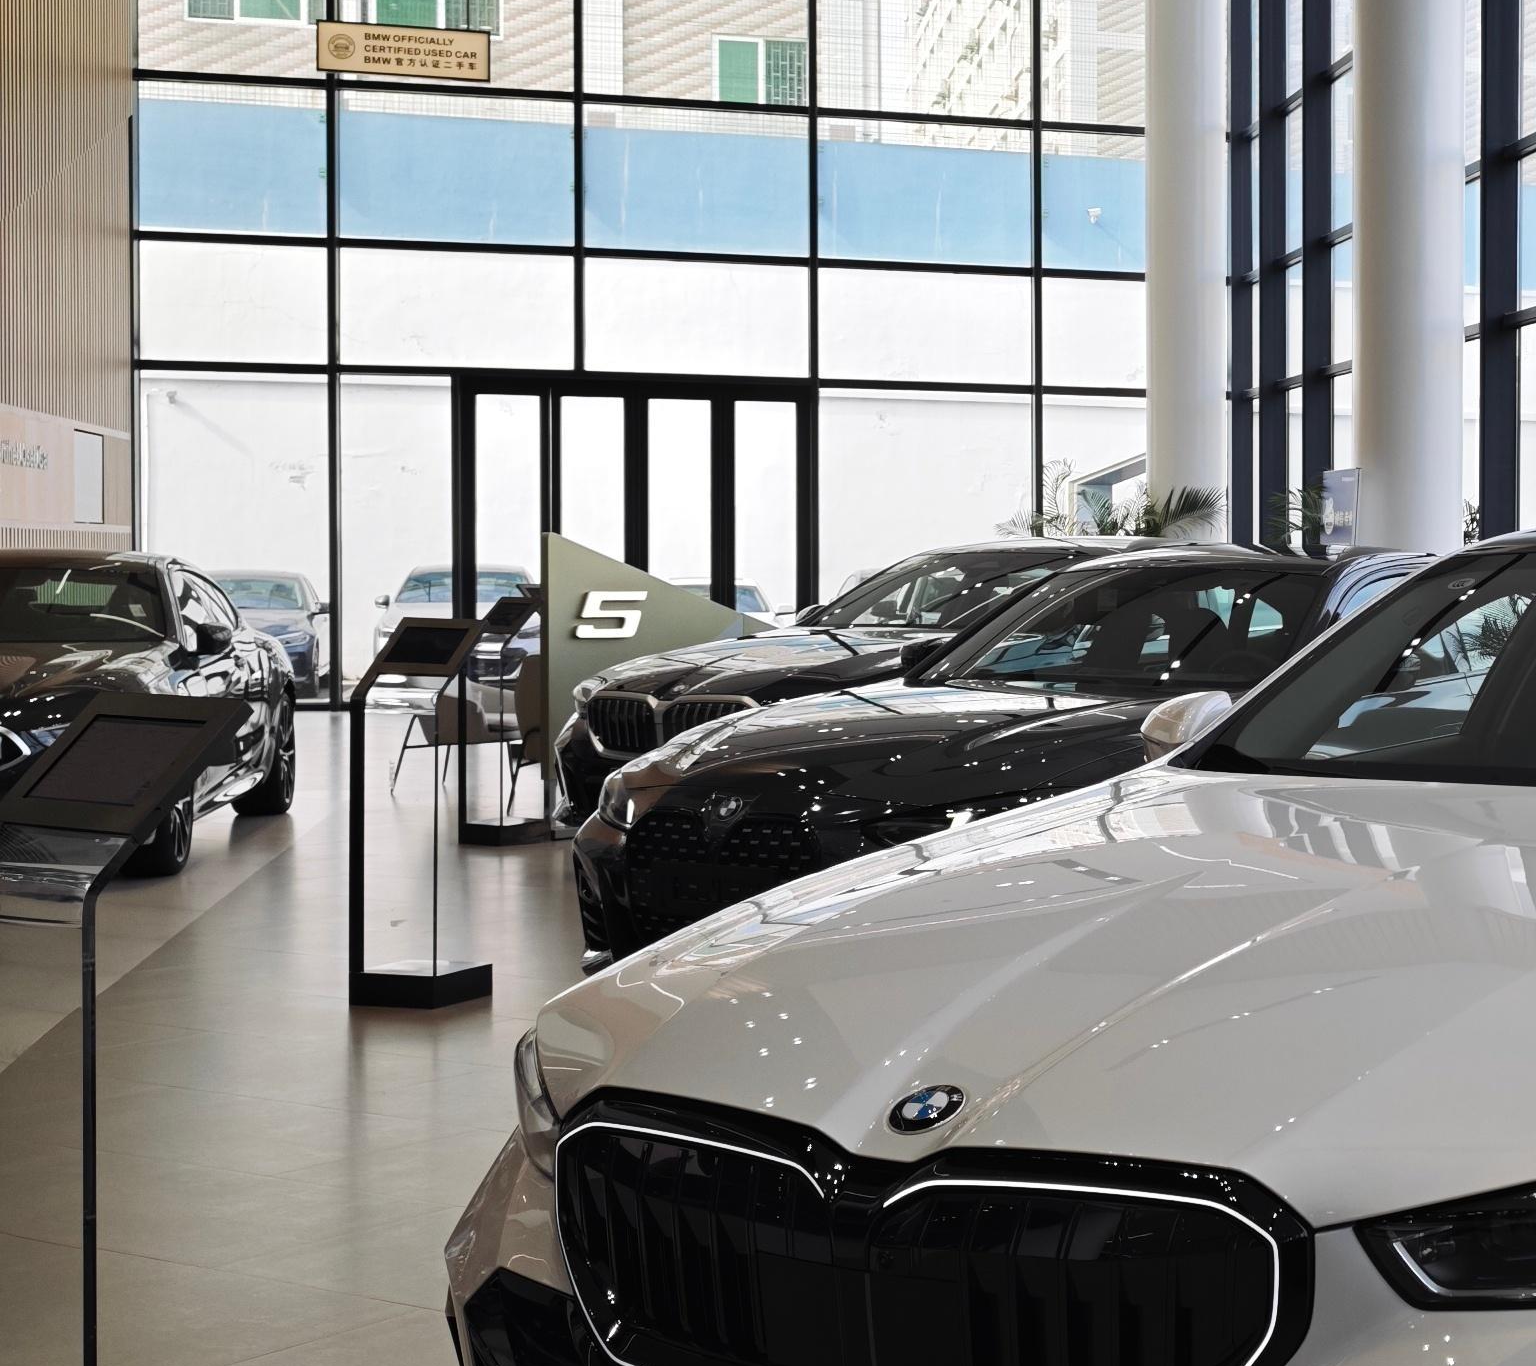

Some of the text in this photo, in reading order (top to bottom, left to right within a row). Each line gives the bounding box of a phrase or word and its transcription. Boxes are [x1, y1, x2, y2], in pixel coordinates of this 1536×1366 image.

[364, 32, 455, 46] BMW OFFICIALLY
[364, 45, 421, 56] CERTIFIED
[423, 46, 453, 58] USED
[455, 50, 477, 59] CAR
[364, 56, 477, 70] BMW 官方认证二手车
[575, 590, 649, 639] 5
